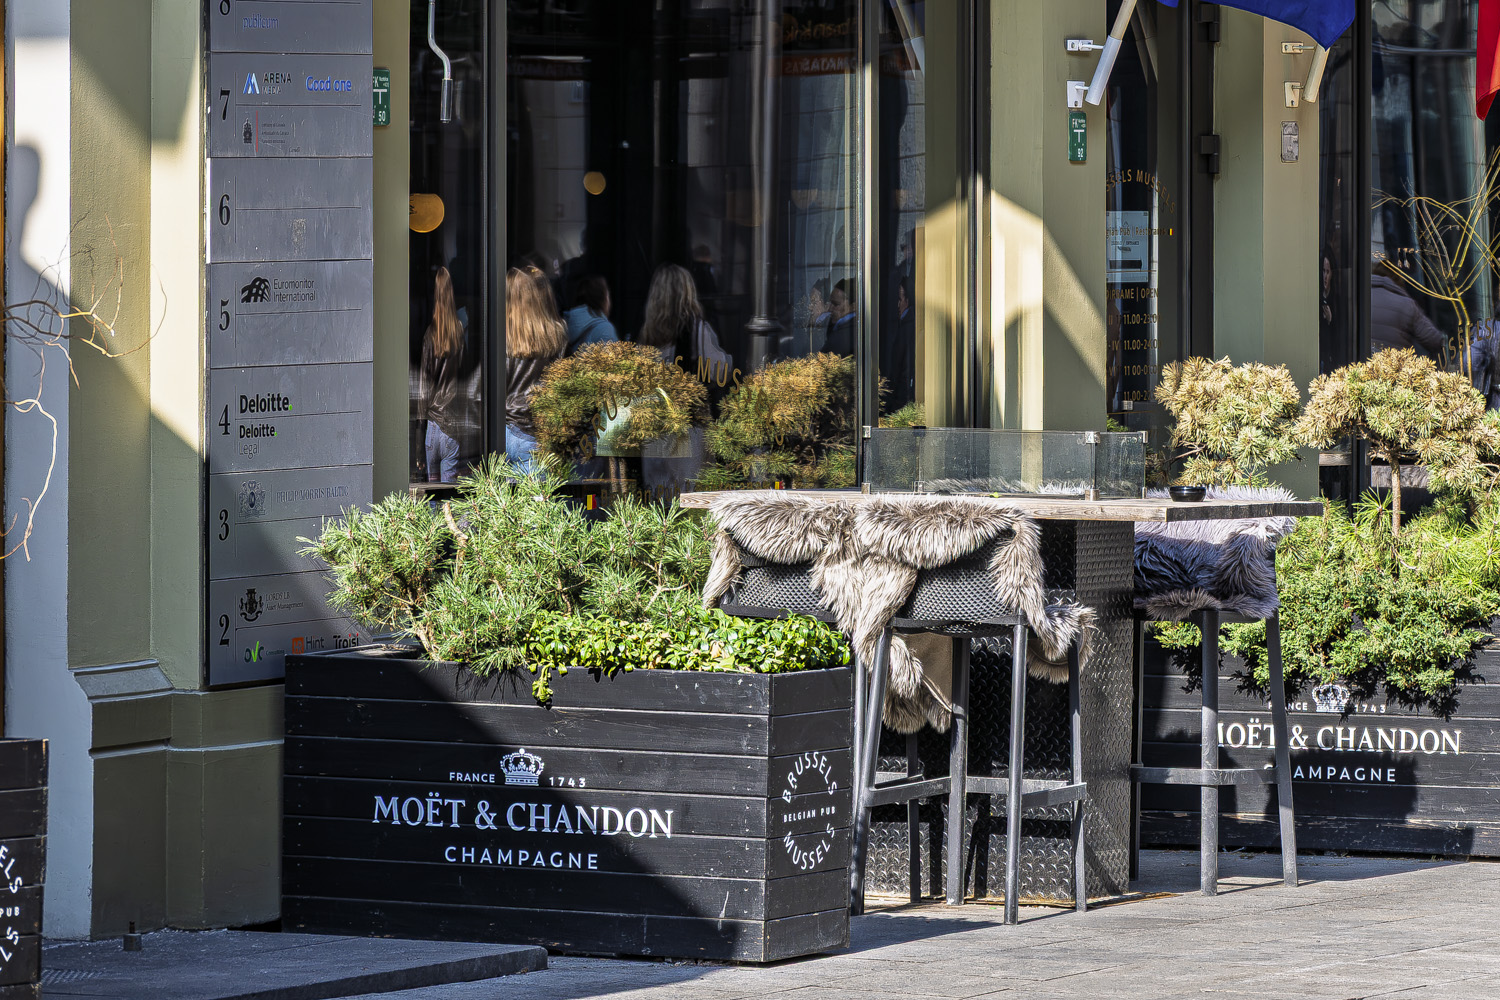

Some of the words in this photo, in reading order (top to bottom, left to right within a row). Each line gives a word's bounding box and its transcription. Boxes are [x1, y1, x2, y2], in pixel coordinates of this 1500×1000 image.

[242, 14, 279, 31] publicum
[263, 73, 292, 84] ARENA
[306, 76, 331, 92] Good
[333, 80, 352, 92] one
[219, 87, 231, 121] 7
[378, 111, 386, 122] 50
[1136, 169, 1176, 214] MUSSELS
[218, 194, 231, 226] 6
[273, 278, 315, 290] Euromonitor
[1141, 287, 1159, 299] OPEN
[273, 290, 316, 303] International
[218, 299, 230, 331] 5
[239, 393, 293, 414] Deloitte.
[218, 404, 231, 436] 4
[239, 424, 278, 439] Deloitte.
[238, 439, 260, 460] Legal
[299, 488, 325, 501] MORRIS
[218, 508, 230, 541] 3
[218, 613, 230, 646] 2
[306, 635, 325, 650] Hint
[1268, 701, 1308, 711] FNCE
[1354, 703, 1387, 714] 1743
[1289, 724, 1310, 750] &
[1317, 725, 1462, 756] CHANDON
[449, 772, 496, 783] FRANCE
[549, 776, 587, 788] 1743
[782, 751, 837, 804] BRUSSELS
[1264, 763, 1397, 783] AMPAGNE
[372, 792, 467, 828] MOËT
[474, 800, 498, 831] &
[506, 802, 675, 839] CHANDON
[783, 809, 816, 823] BELGIAN
[820, 806, 836, 816] PUB
[783, 823, 835, 871] MUSSELS
[444, 846, 598, 870] CHAMPAGNE
